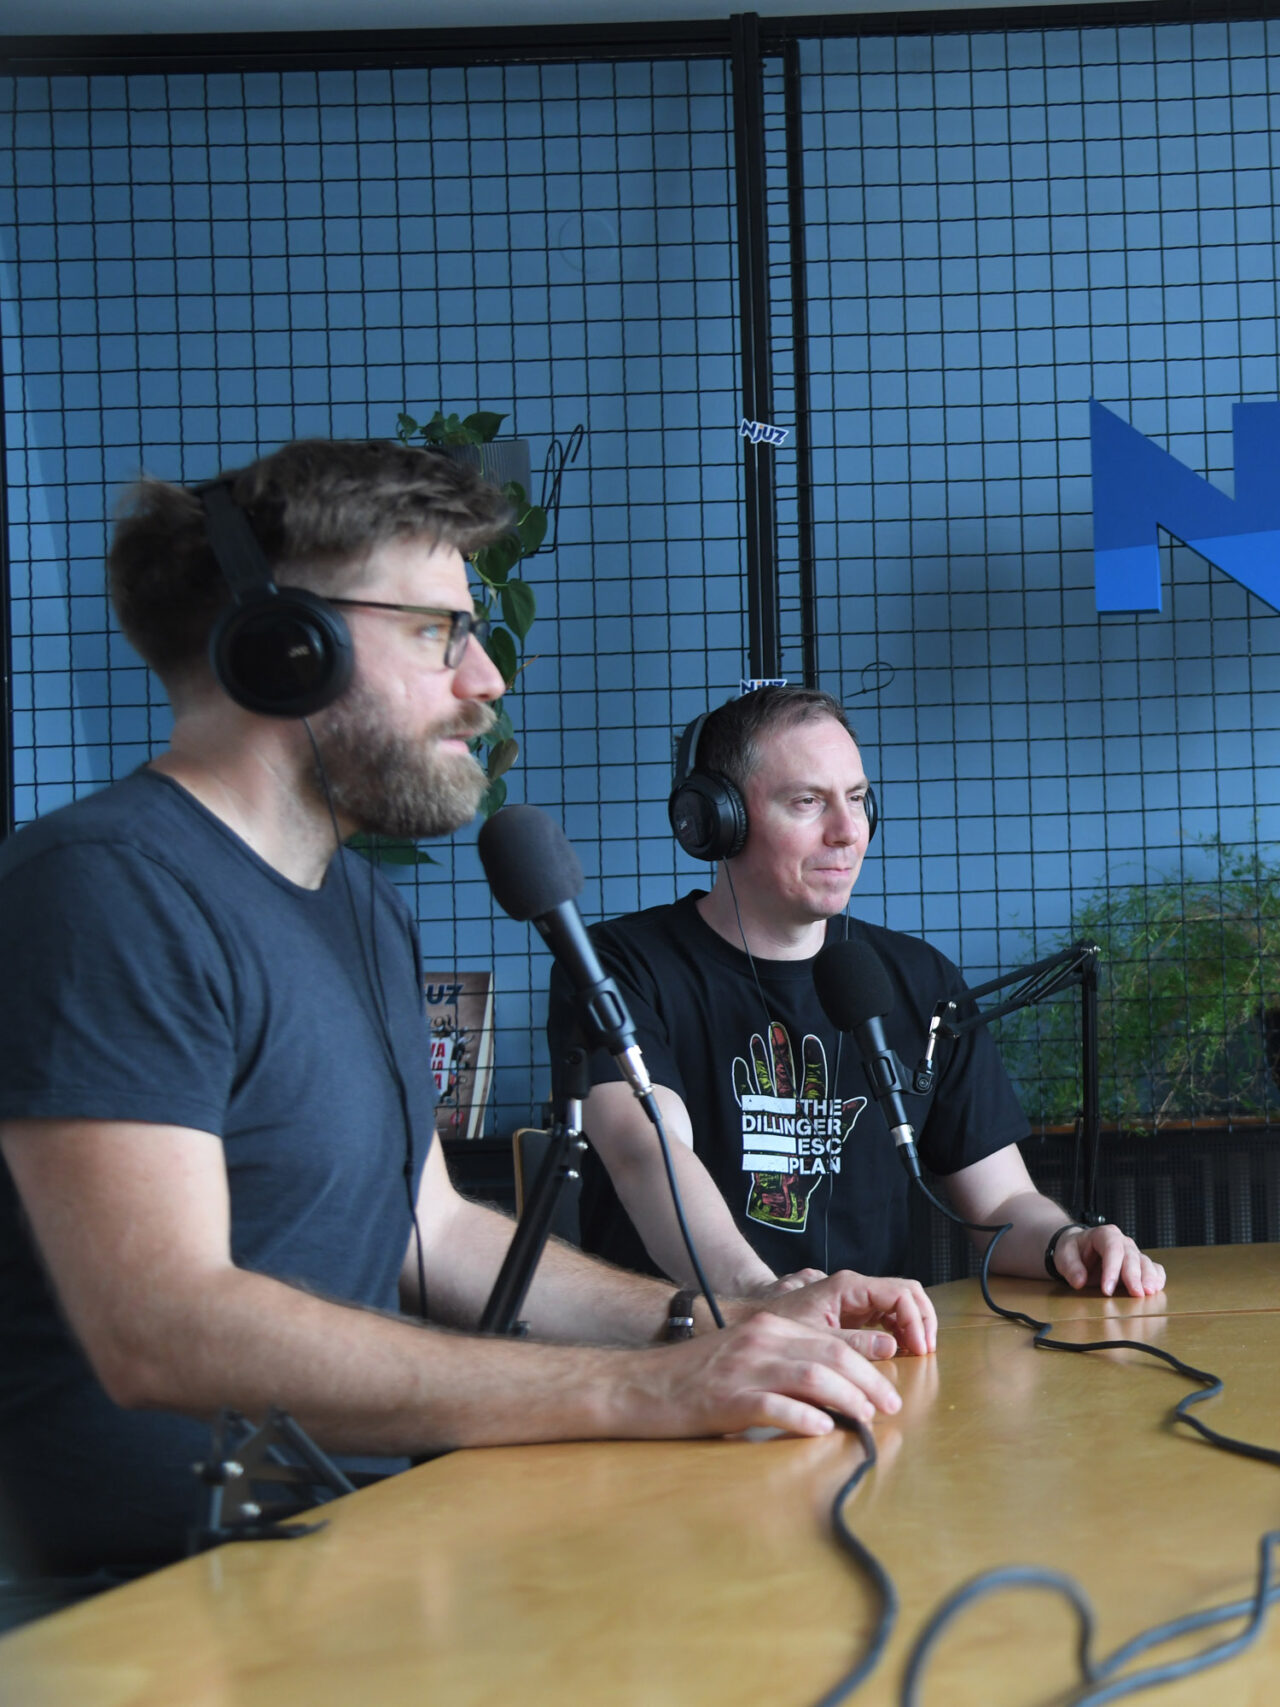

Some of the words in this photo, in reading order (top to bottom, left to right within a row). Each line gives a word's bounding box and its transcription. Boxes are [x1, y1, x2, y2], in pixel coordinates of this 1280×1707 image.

[426, 983, 465, 1005] UZ
[800, 1099, 842, 1115] THE
[742, 1115, 842, 1135] DILLINGER
[798, 1138, 842, 1155] ESC
[789, 1157, 841, 1175] PLAN
